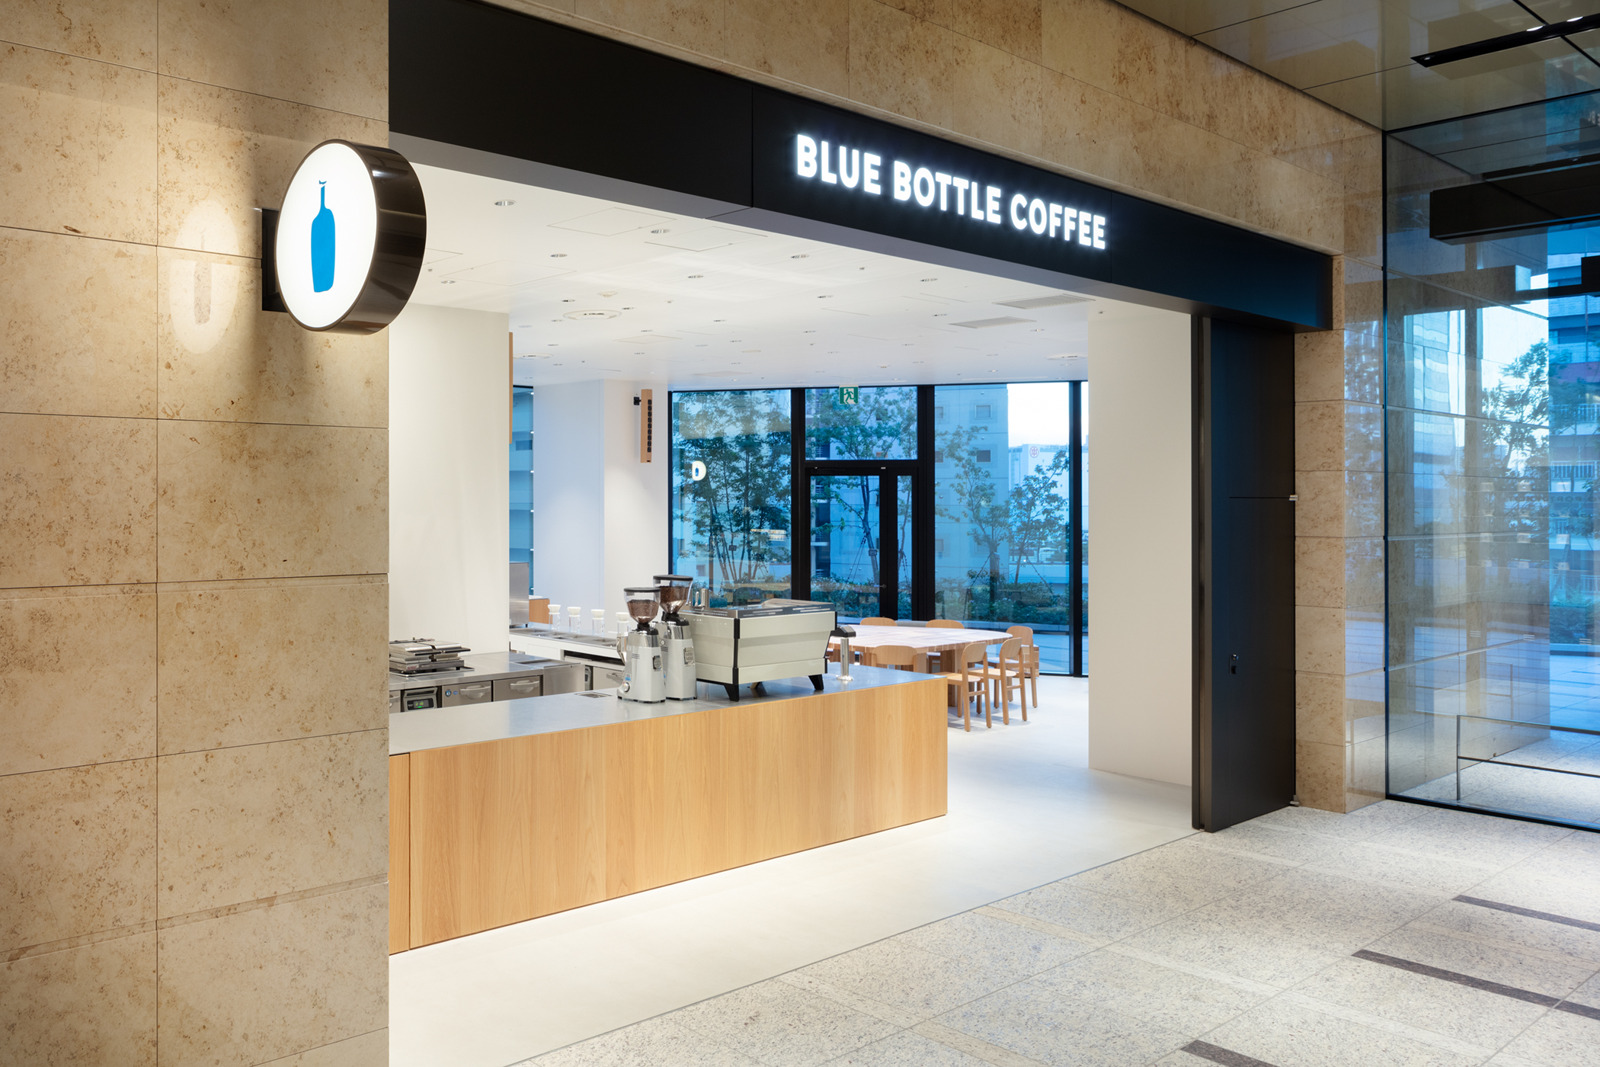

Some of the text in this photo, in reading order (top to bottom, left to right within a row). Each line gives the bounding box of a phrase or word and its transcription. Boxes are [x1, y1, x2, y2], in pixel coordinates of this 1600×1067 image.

[796, 133, 1106, 250] BLUE BOTTLE COFFEE
